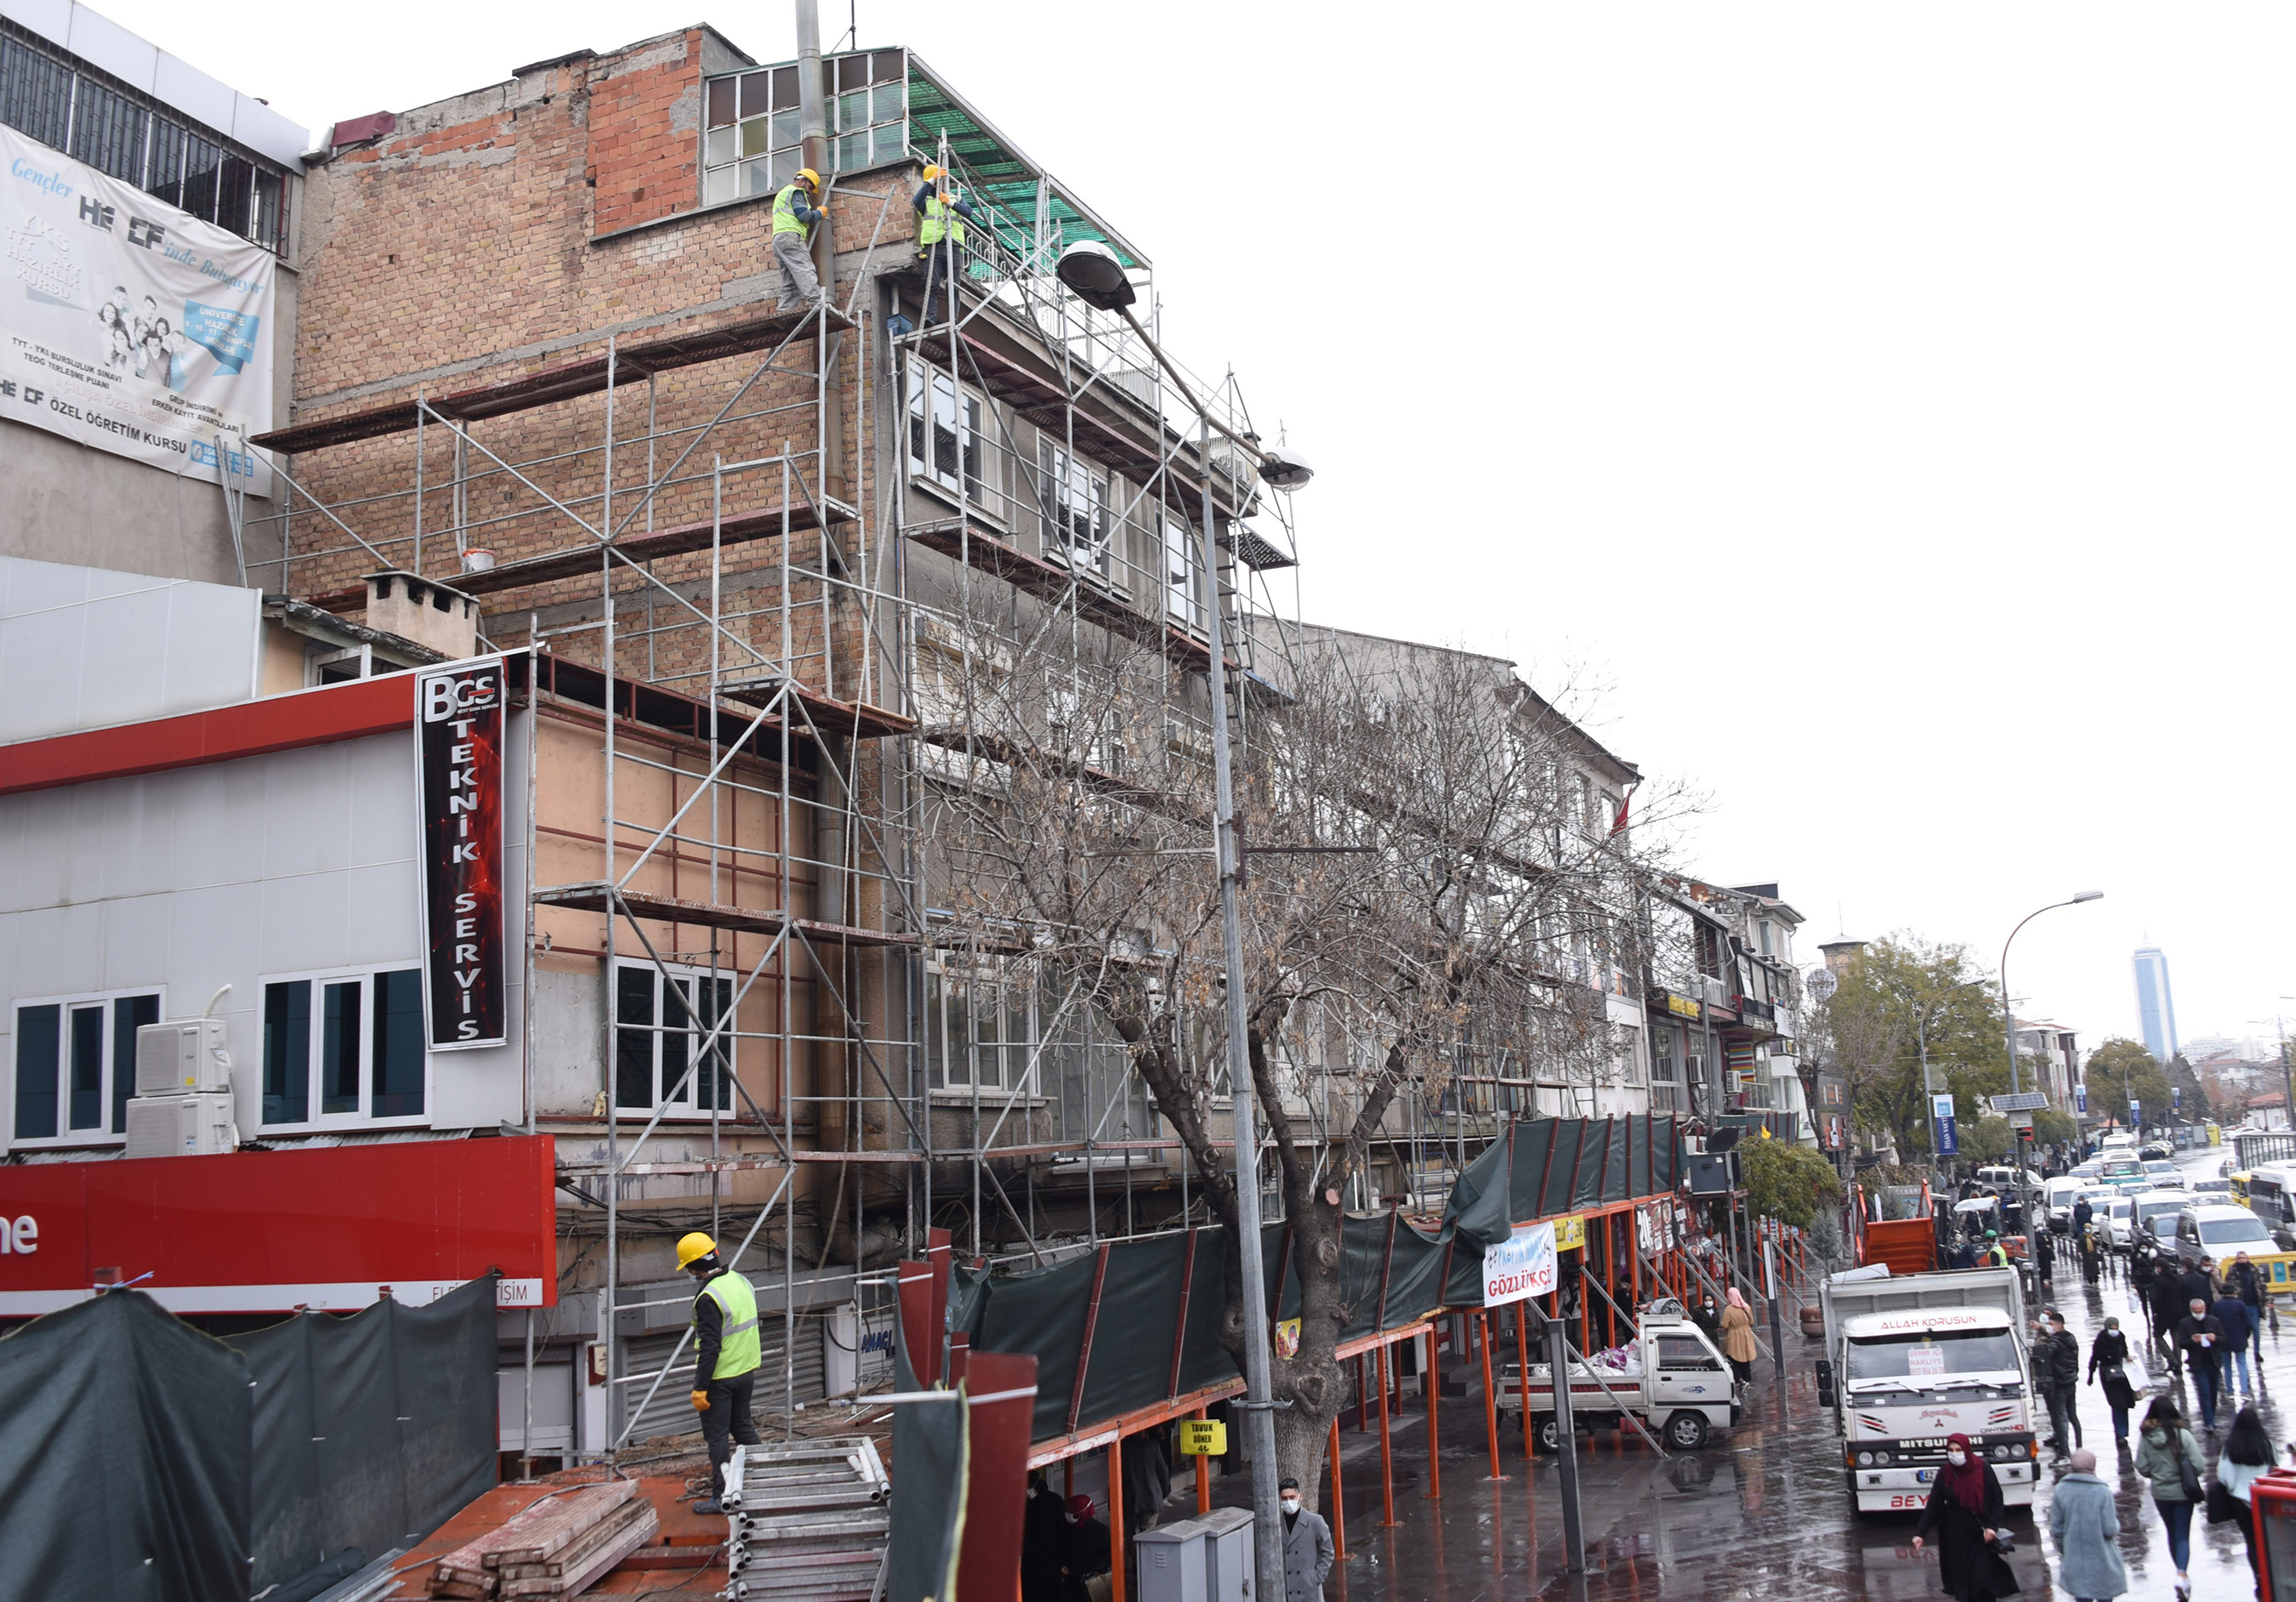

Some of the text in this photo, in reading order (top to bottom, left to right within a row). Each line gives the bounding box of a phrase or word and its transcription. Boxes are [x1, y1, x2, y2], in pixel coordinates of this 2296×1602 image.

[12, 157, 73, 197] Gençler
[12, 337, 28, 349] TYT
[51, 352, 95, 374] BURSLULUK
[98, 368, 122, 383] SINAVI
[24, 352, 110, 390] TEOG YERLEŞME PUANI
[169, 395, 185, 406] GRUP
[50, 396, 82, 421] ÖZEL
[87, 410, 140, 441] ÖĞRETİM
[144, 433, 186, 454] KURSU
[425, 676, 496, 723] BGS
[447, 718, 482, 1040] TEKNİK SERVİS
[1881, 1315, 1977, 1330] ALLAH KORUSUN
[1191, 1423, 1213, 1432] TAVUK
[1193, 1434, 1212, 1444] DÖNER
[1899, 1436, 1983, 1448] MITSUHI
